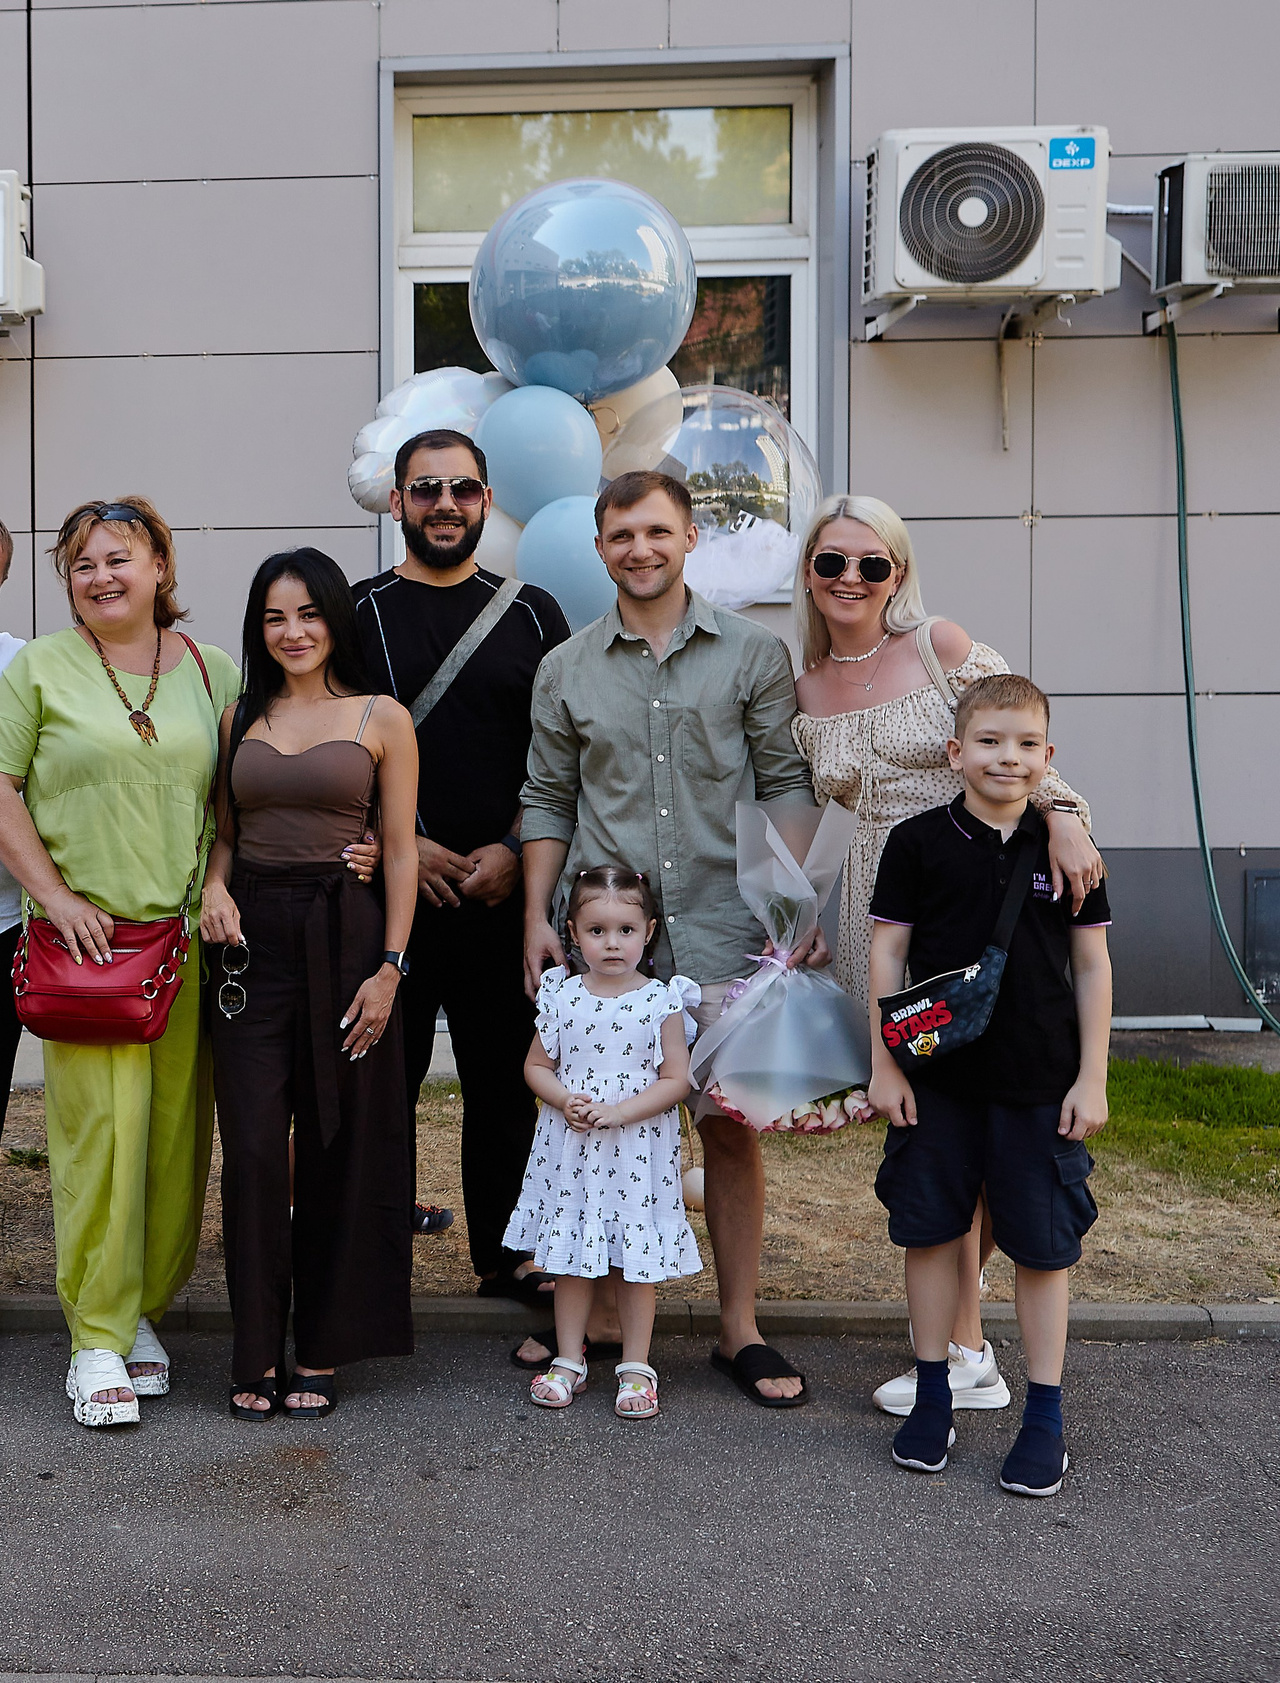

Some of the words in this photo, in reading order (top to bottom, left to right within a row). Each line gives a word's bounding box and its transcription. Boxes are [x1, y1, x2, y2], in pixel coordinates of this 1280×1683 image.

[1052, 157, 1091, 168] DEXP
[1033, 872, 1046, 882] I'M
[1033, 881, 1053, 892] GRE
[890, 997, 933, 1023] BRAWL
[882, 1000, 953, 1048] STARS
